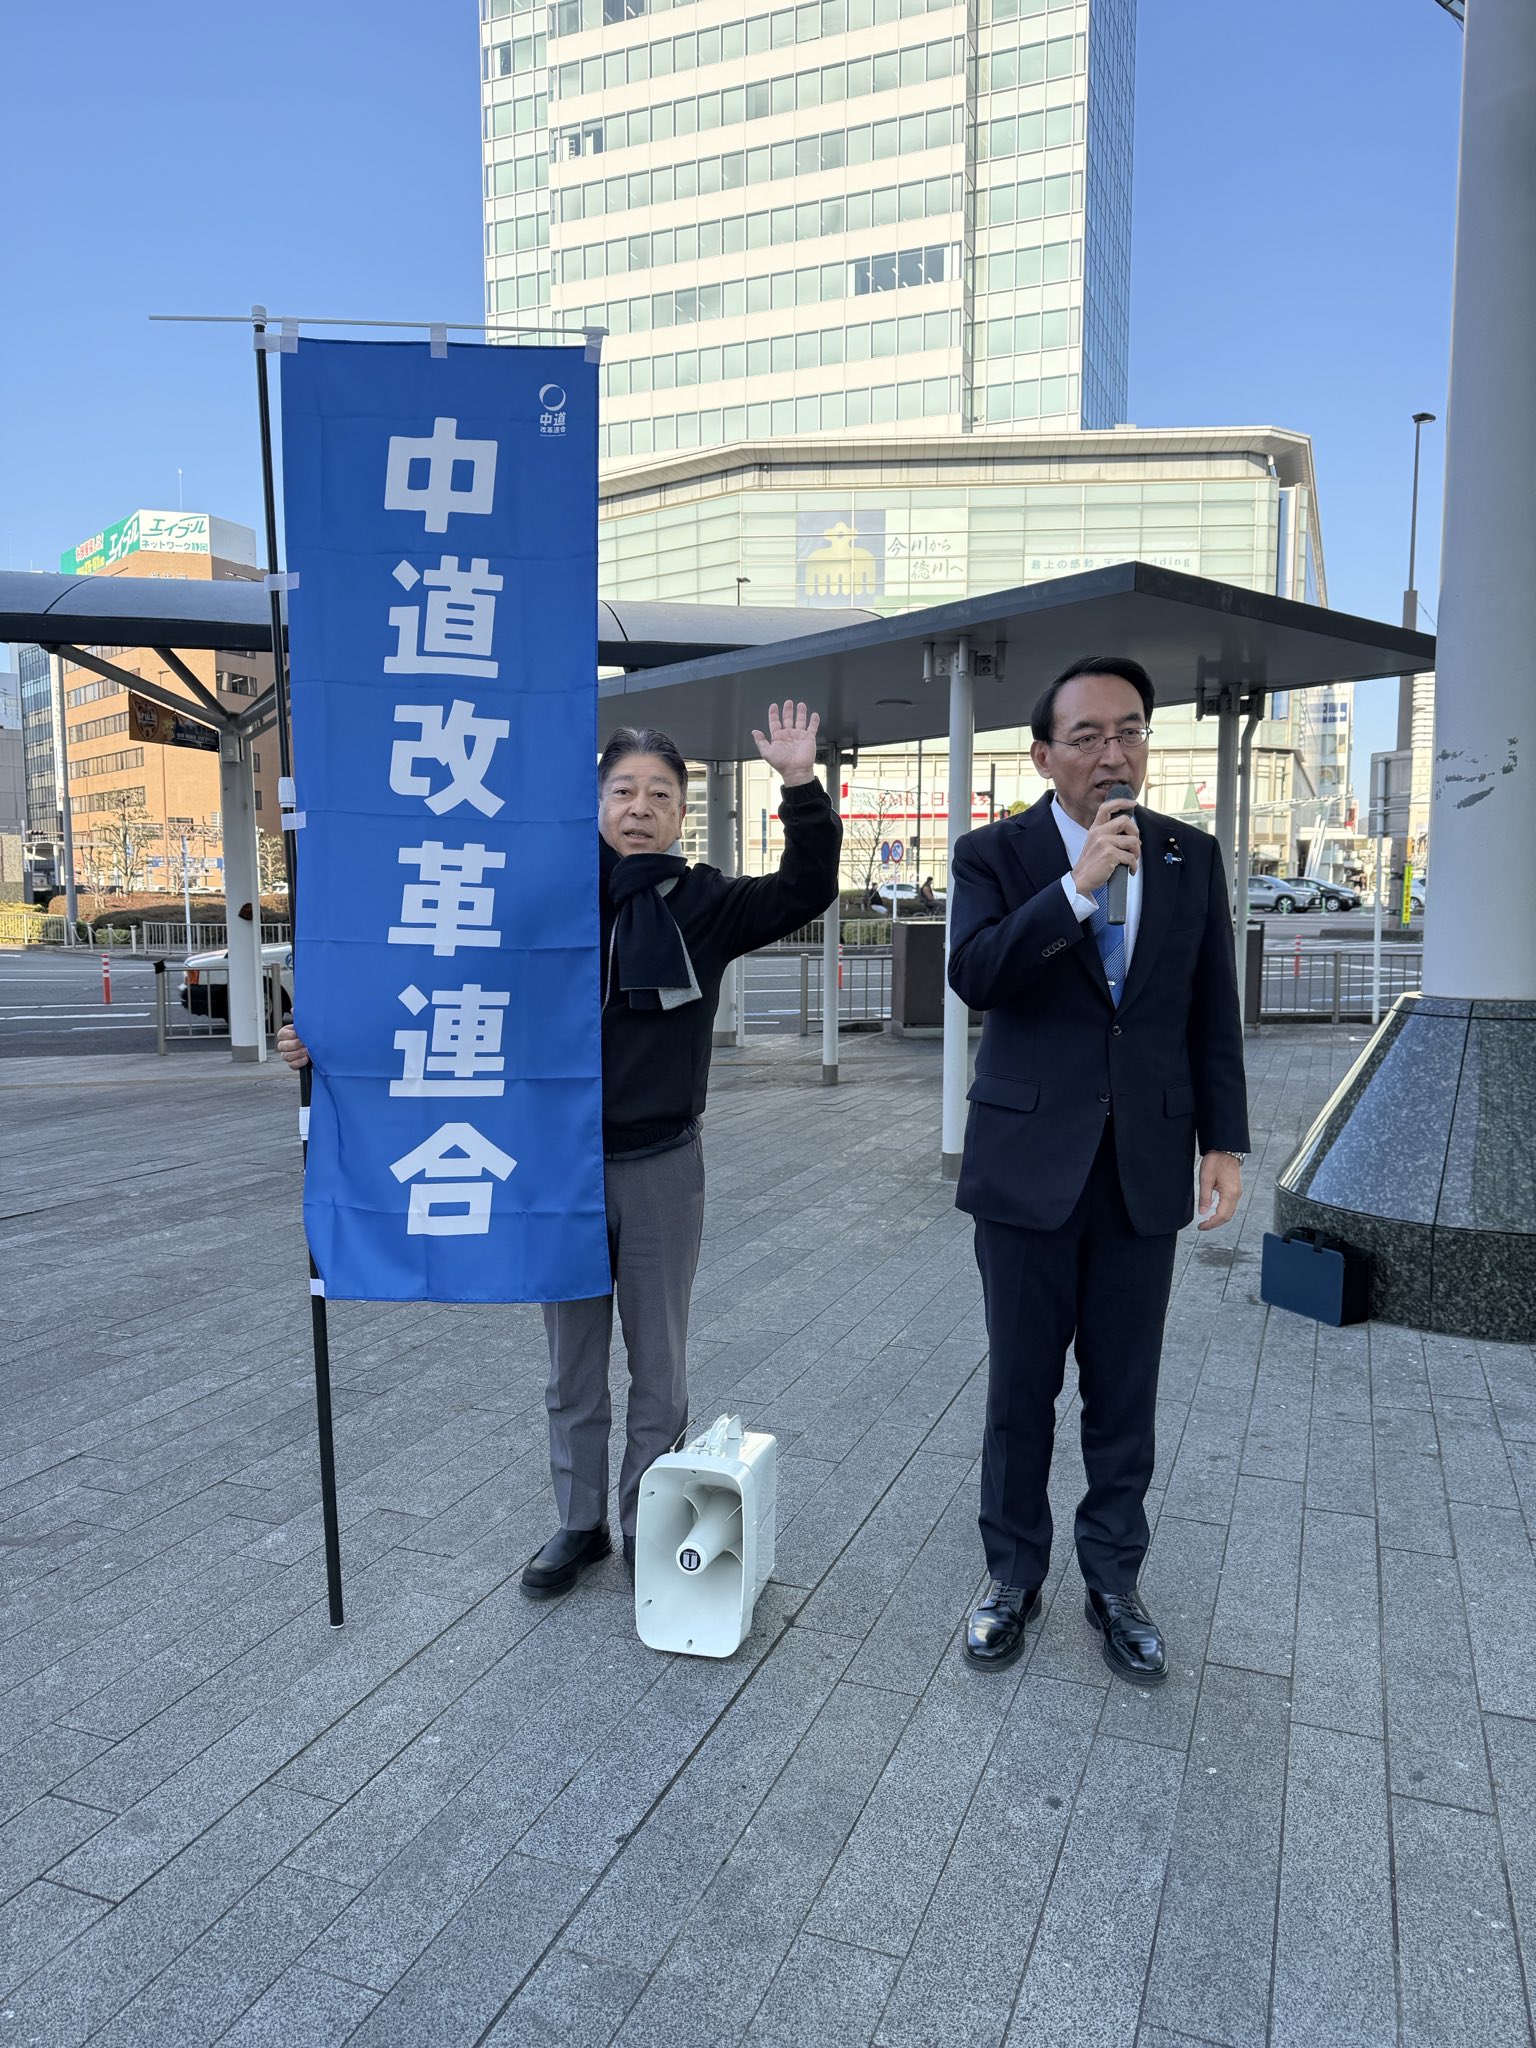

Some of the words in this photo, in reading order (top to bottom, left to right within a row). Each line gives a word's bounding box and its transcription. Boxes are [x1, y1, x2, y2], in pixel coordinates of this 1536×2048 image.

[540, 412, 567, 426] 中道
[142, 515, 207, 538] エイブル
[105, 511, 139, 567] エイブル
[141, 540, 209, 552] ネットワーク静岡
[887, 536, 951, 557] 今川から
[383, 417, 517, 1236] 中道改革連合
